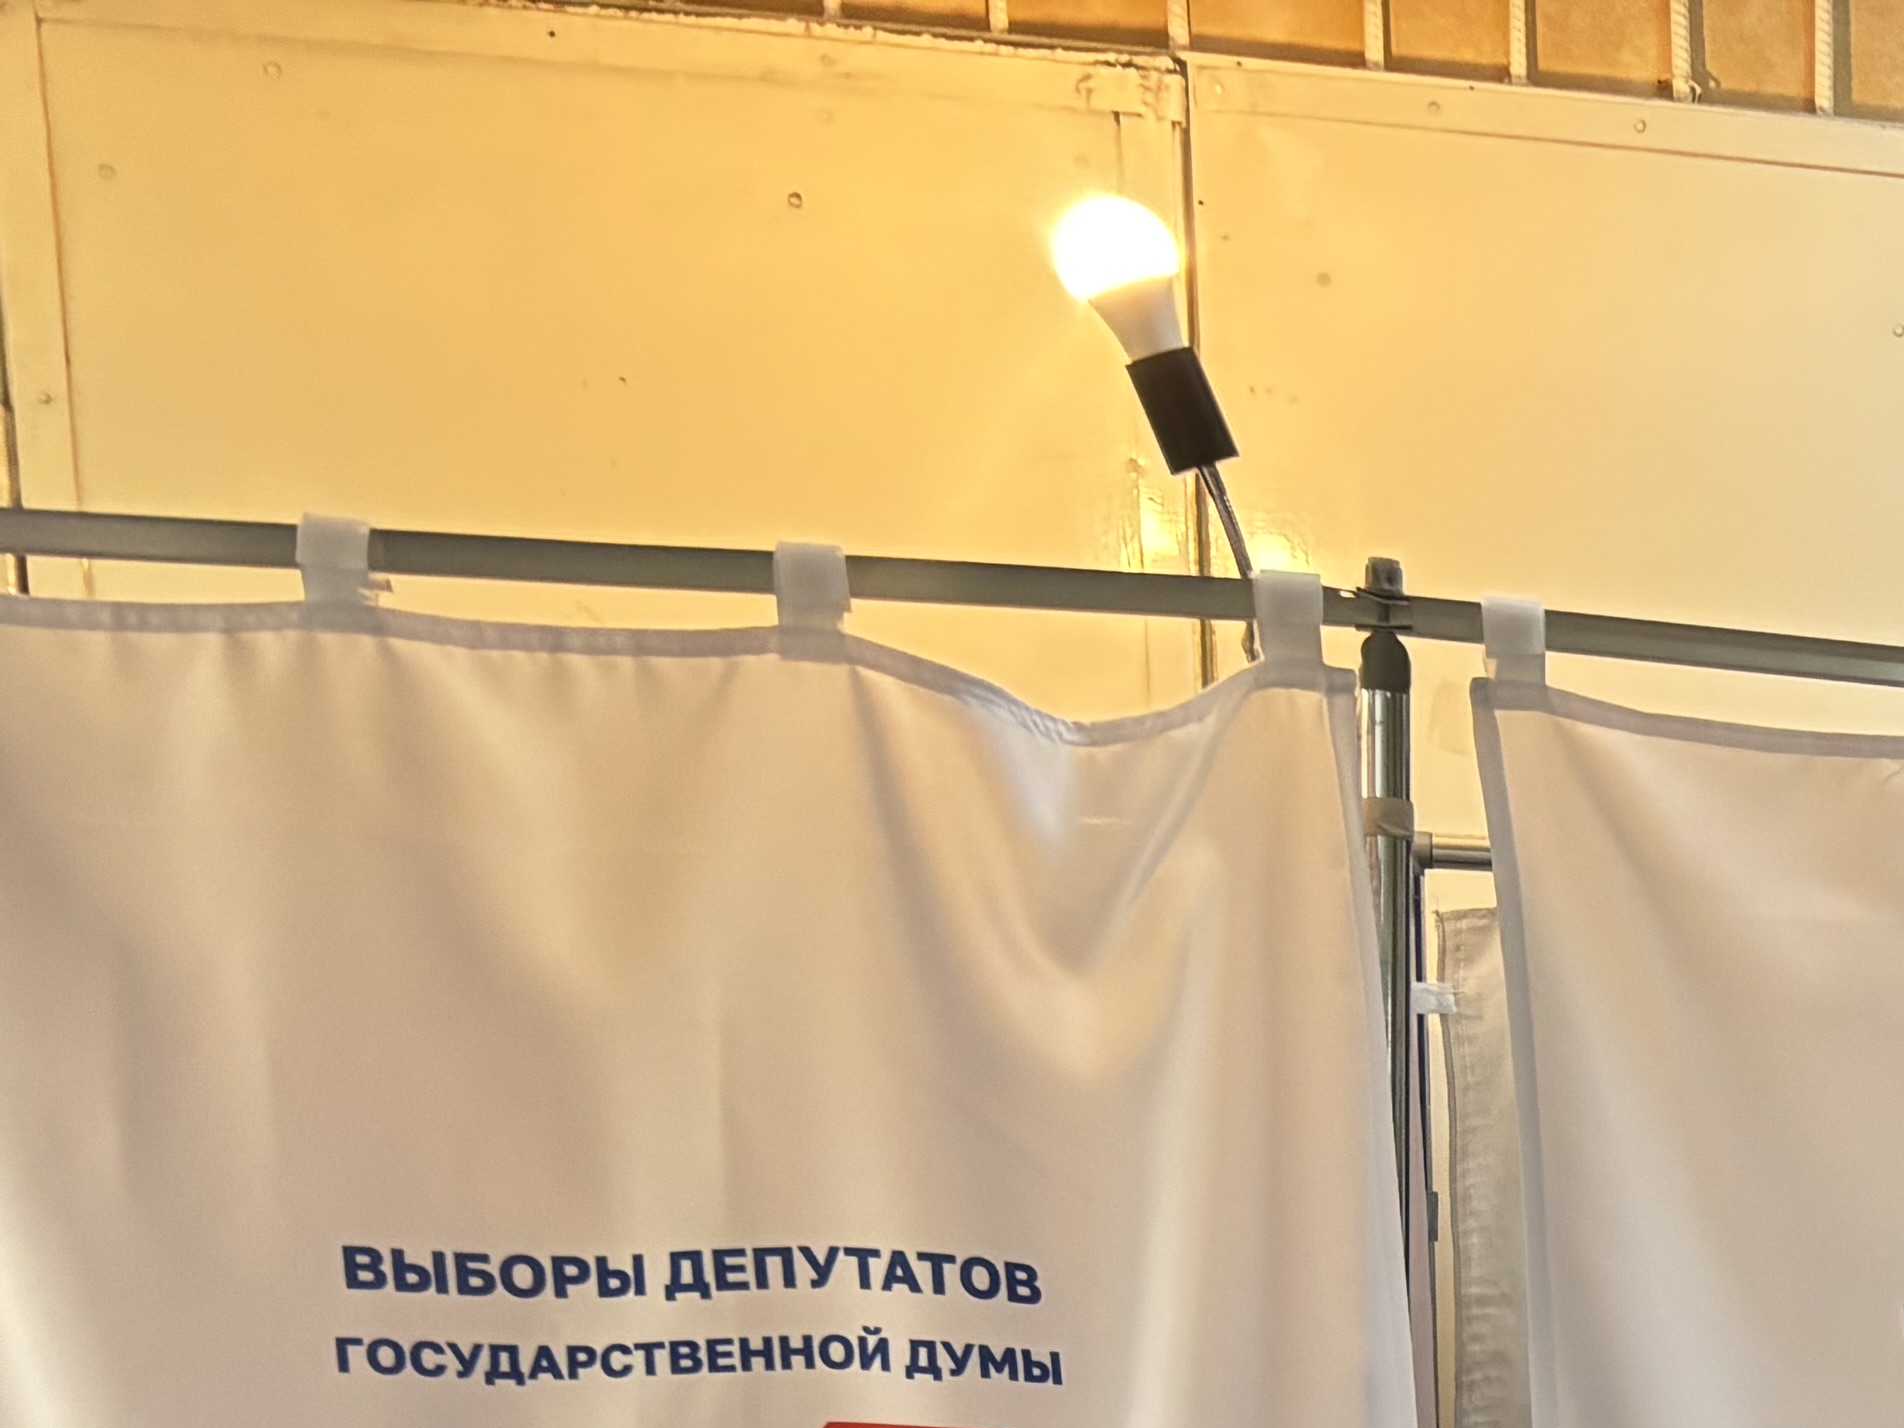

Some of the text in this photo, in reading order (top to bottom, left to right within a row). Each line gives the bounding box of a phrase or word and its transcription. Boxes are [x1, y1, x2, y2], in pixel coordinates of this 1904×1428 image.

[342, 1246, 1041, 1304] ВЫБОРЫ ДЕПУТАТОВ
[334, 1329, 1062, 1386] ГОСУДАРСТВЕННОЙ ДУМЫ
